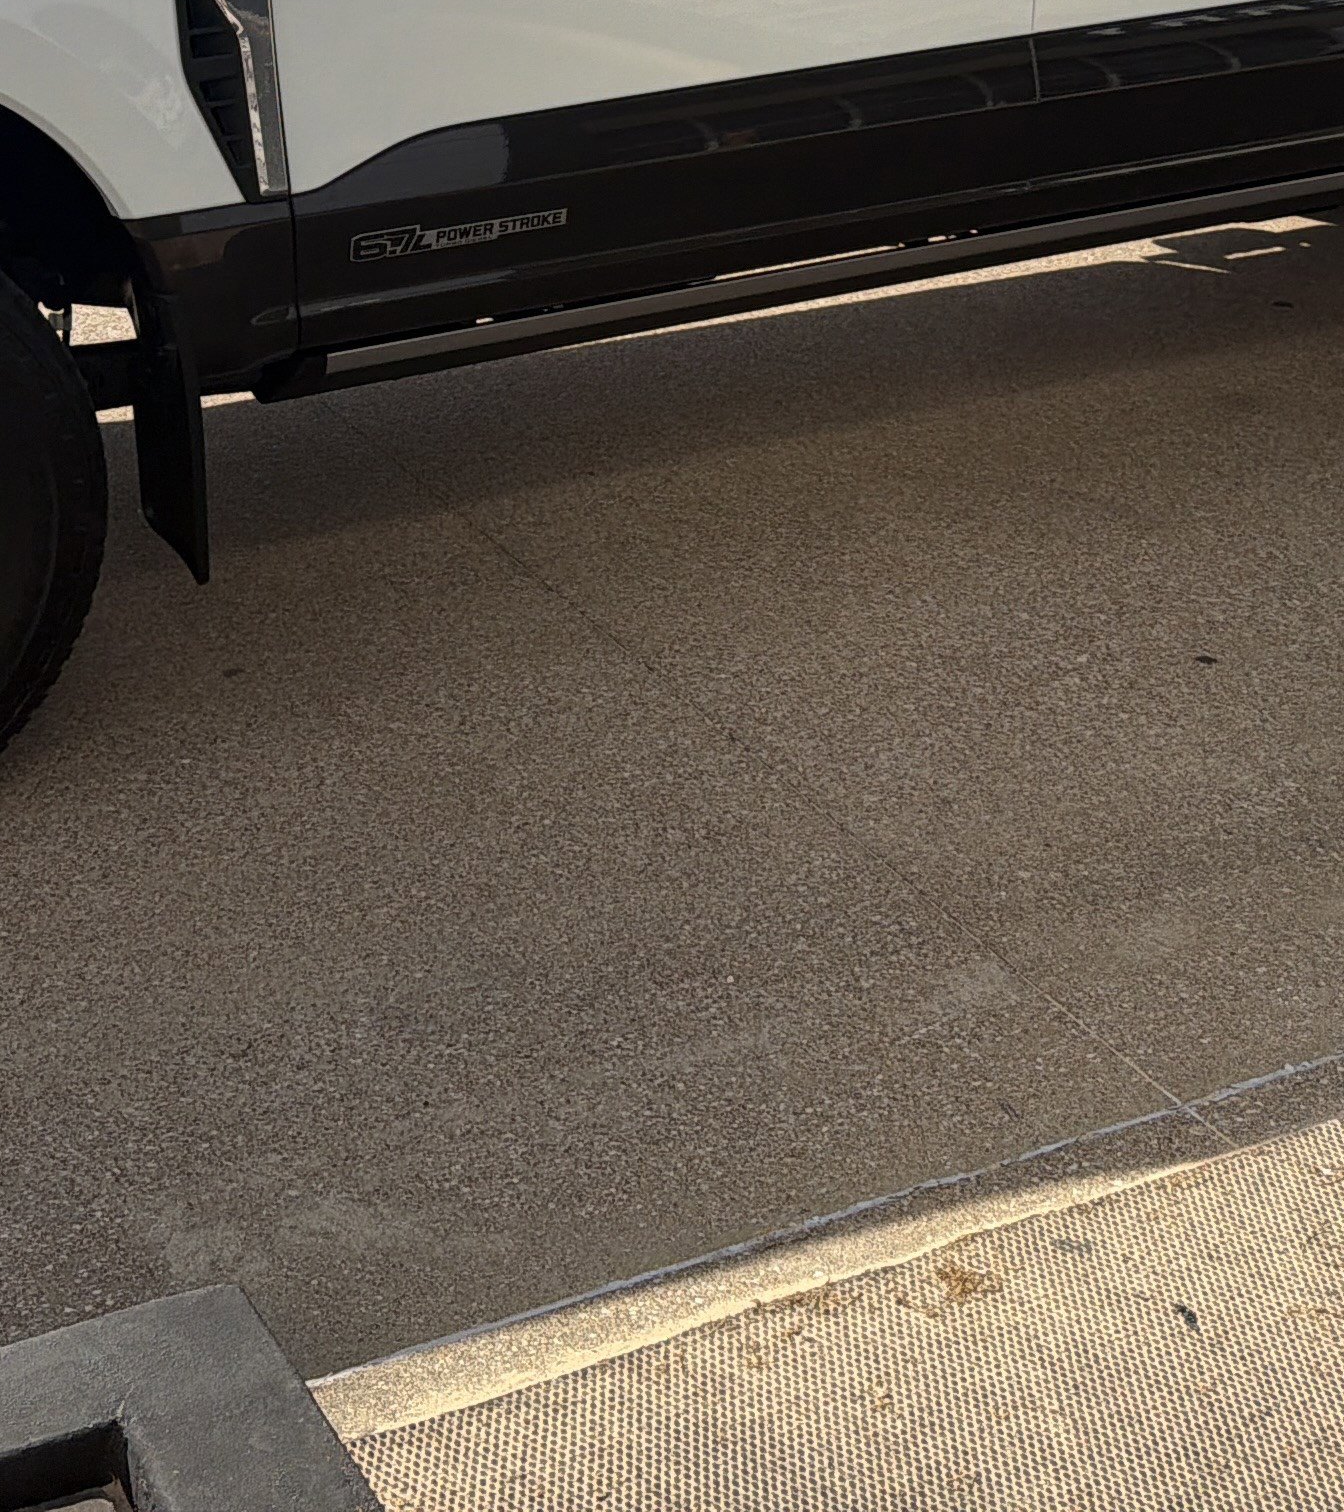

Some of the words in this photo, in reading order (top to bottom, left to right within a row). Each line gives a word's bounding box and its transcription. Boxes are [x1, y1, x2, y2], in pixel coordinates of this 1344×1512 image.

[350, 225, 434, 262] 6.7L
[435, 221, 495, 244] POWER
[497, 211, 563, 235] STROKE
